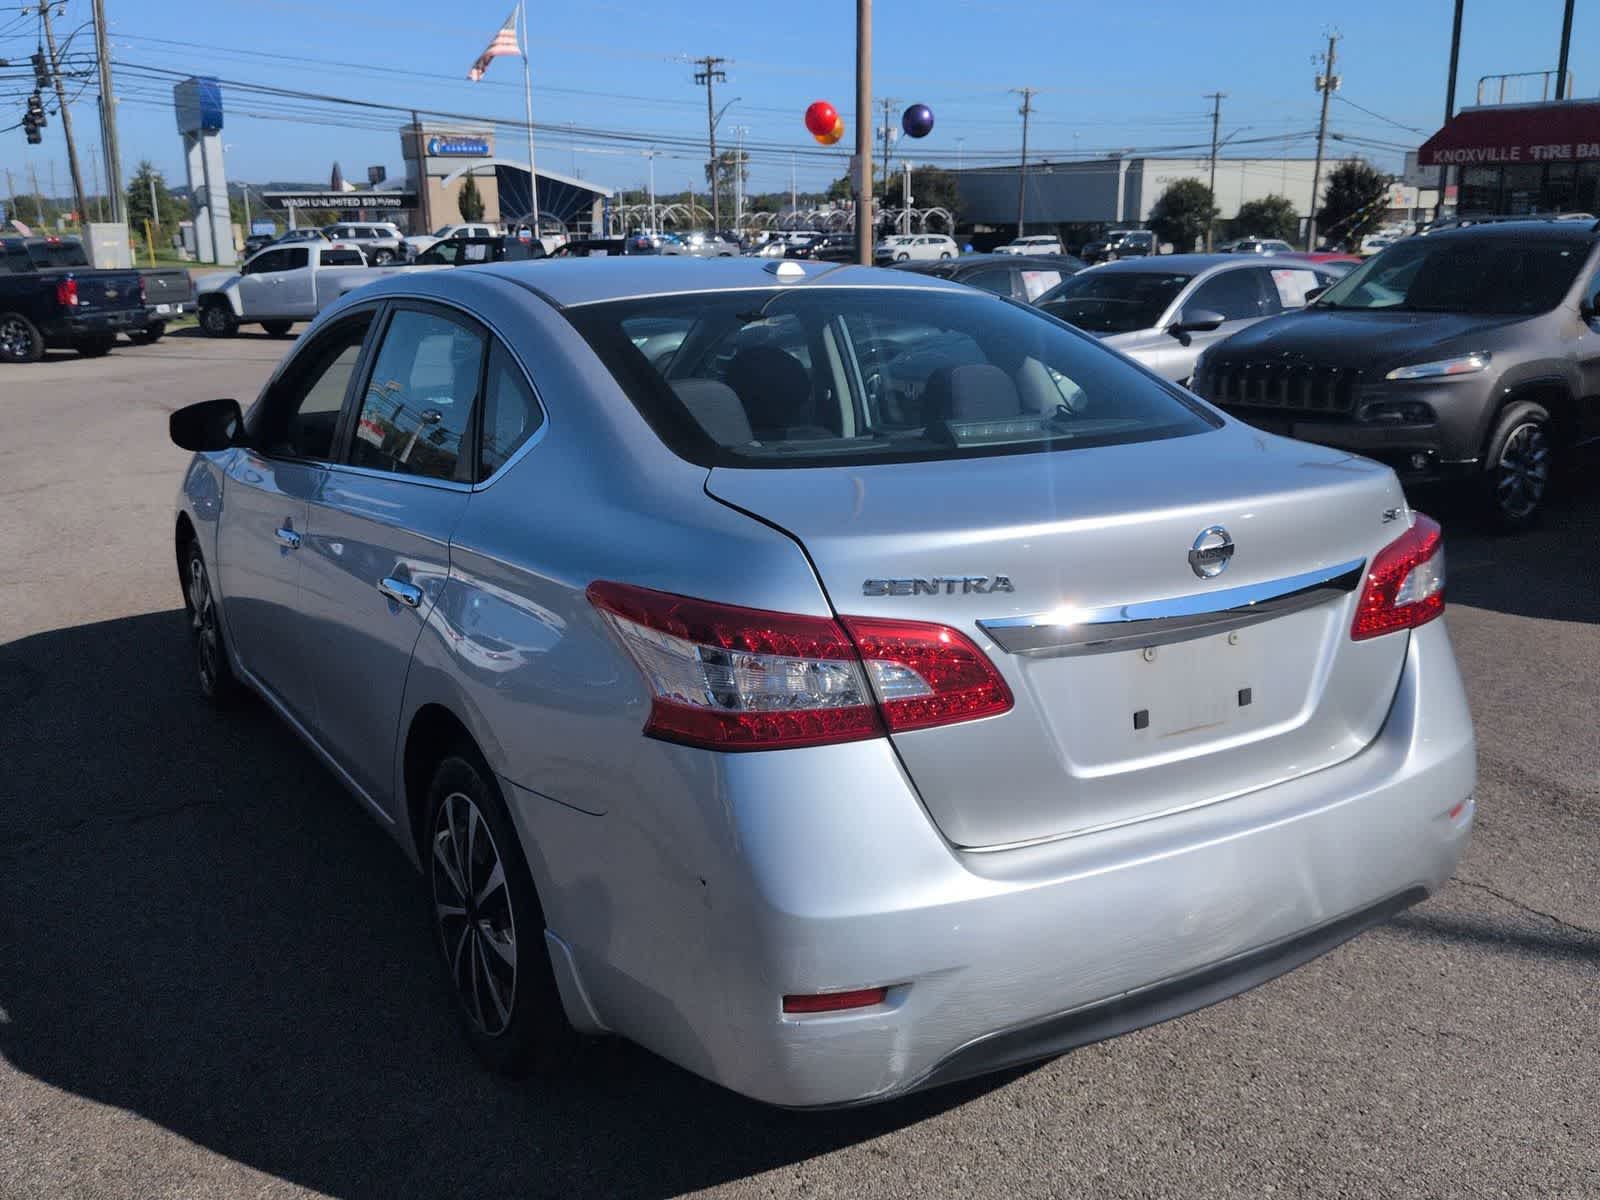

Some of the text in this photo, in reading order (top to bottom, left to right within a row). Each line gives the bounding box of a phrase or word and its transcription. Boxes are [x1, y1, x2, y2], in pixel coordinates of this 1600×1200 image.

[1432, 146, 1521, 163] KNOXVILLE
[1529, 144, 1573, 161] TIRE
[281, 198, 309, 207] WASH
[311, 198, 360, 207] UNLIMITED
[863, 576, 1015, 596] SENTRA
